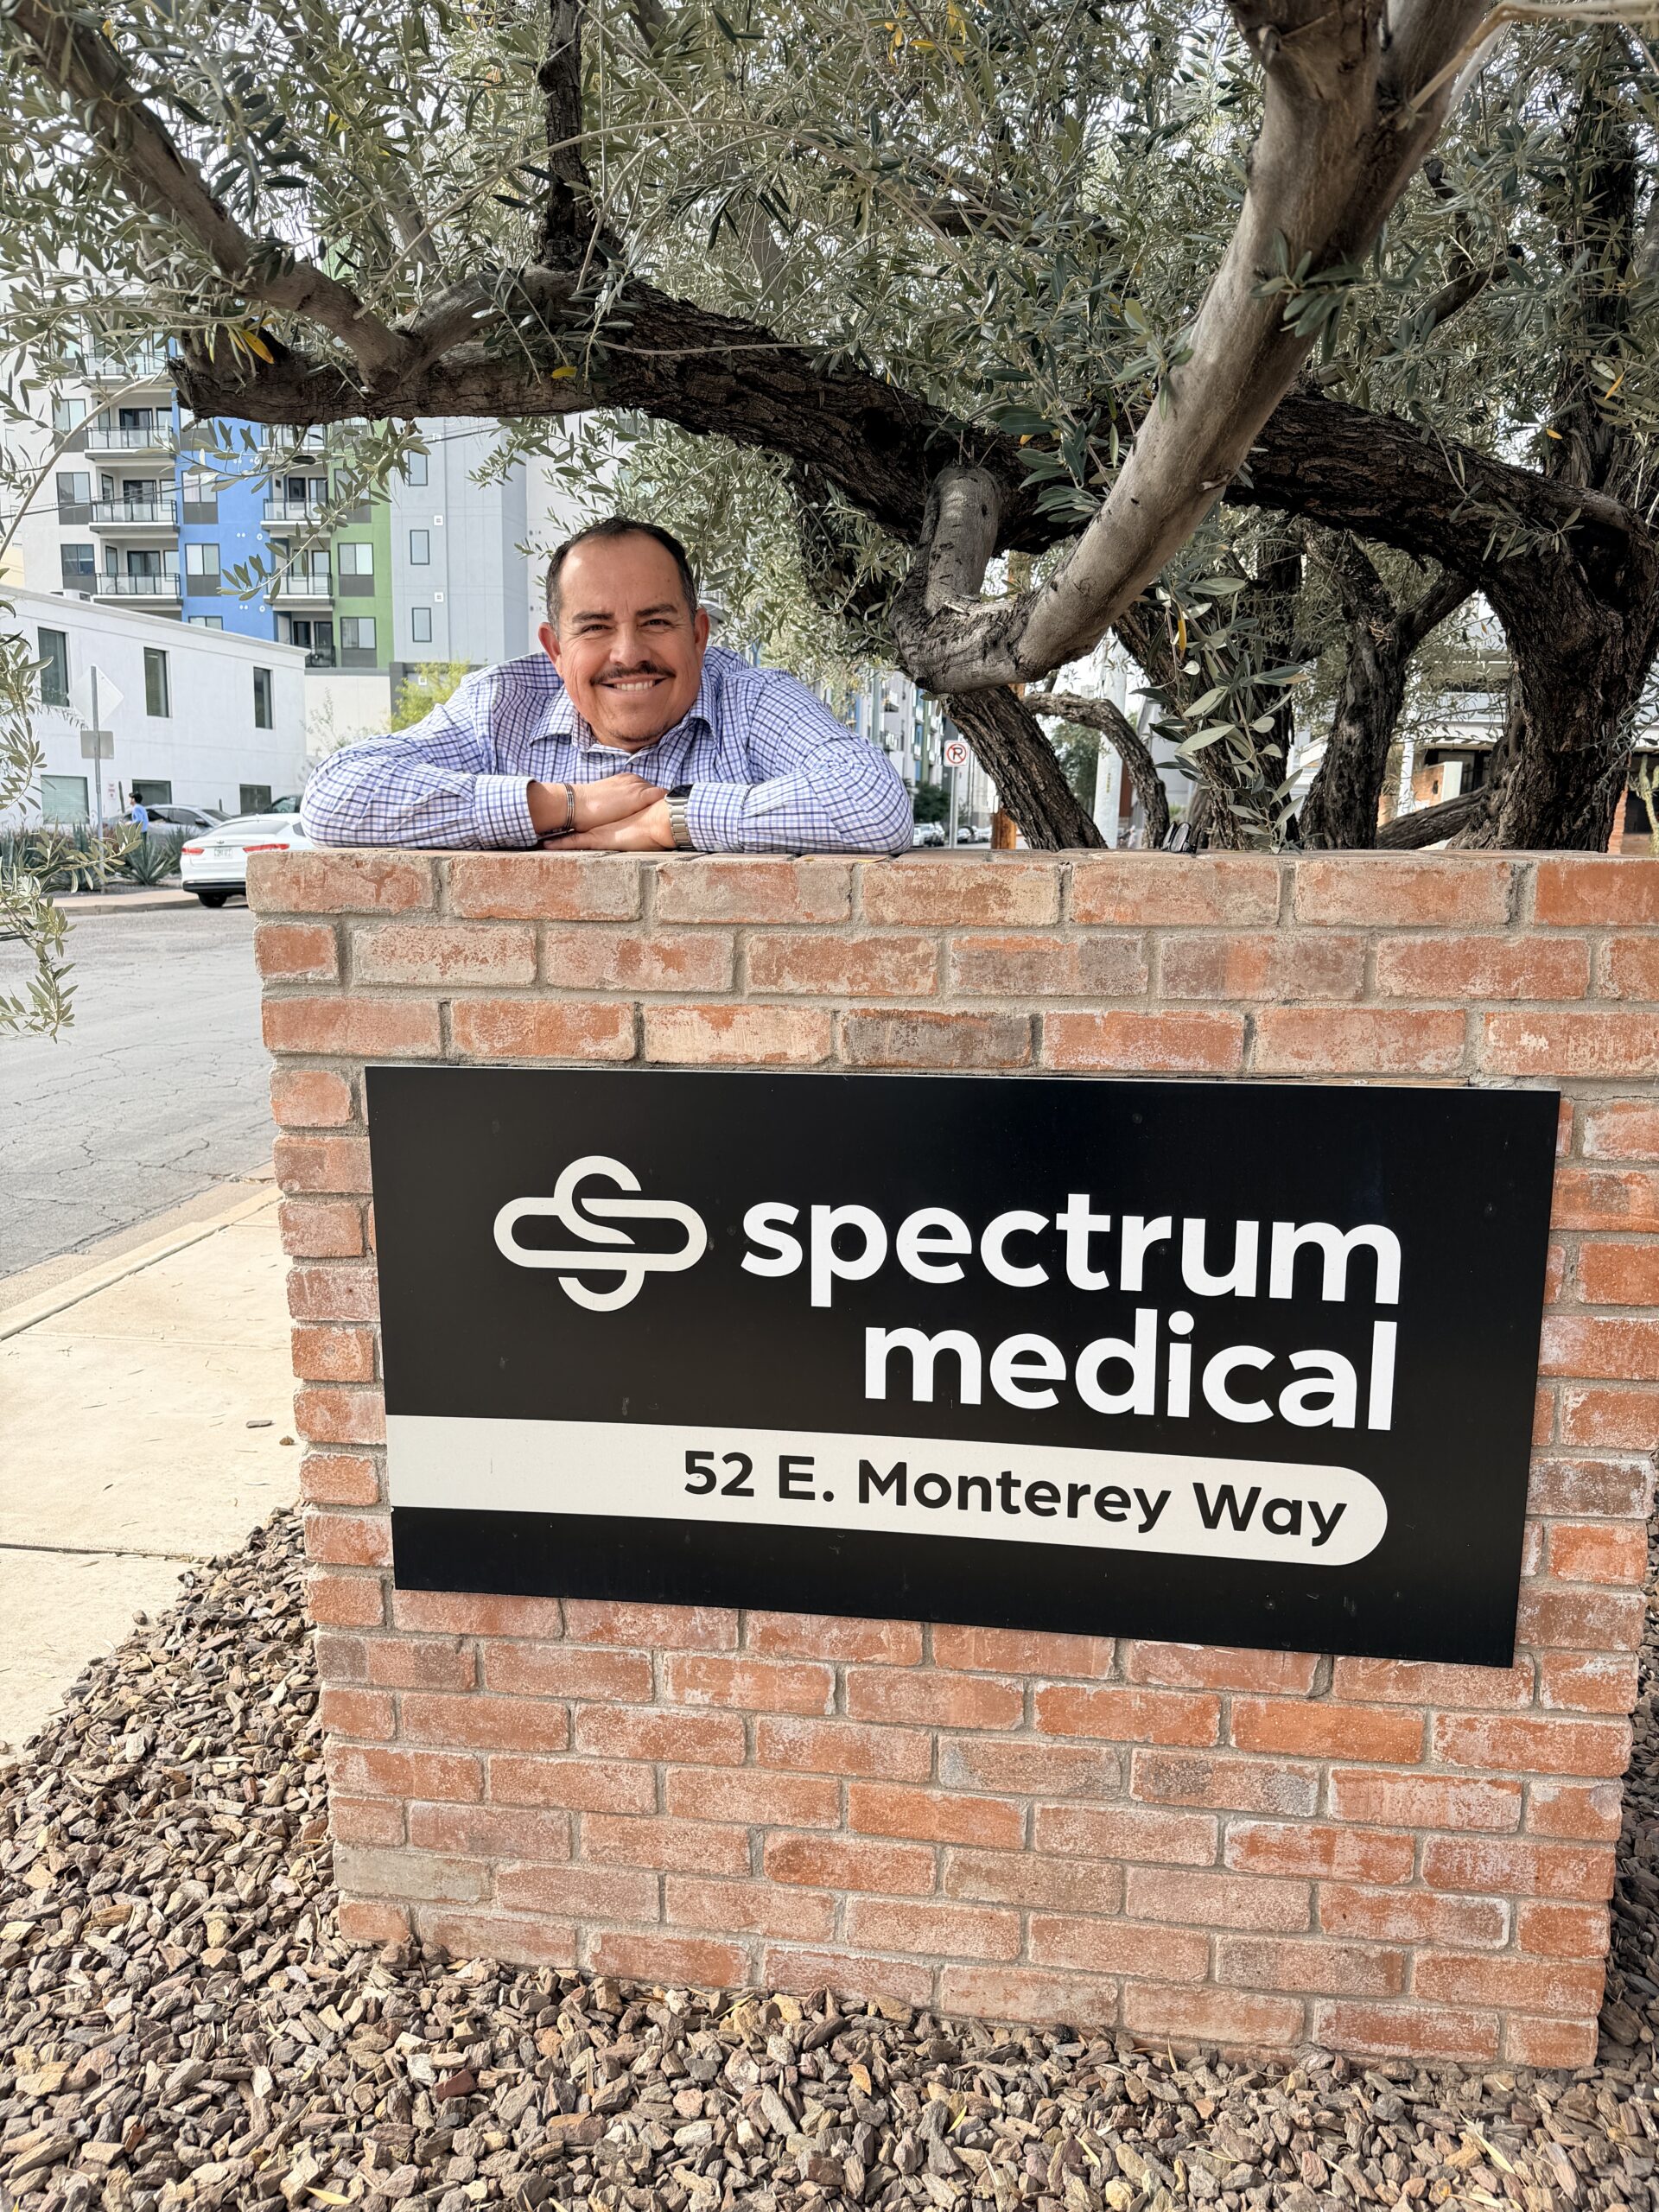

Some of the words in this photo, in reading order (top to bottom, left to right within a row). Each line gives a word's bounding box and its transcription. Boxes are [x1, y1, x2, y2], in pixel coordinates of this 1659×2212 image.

[741, 1193, 1402, 1308] spectrum
[865, 1310, 1398, 1431] medical
[685, 1451, 754, 1497] 52
[779, 1454, 835, 1503] E.
[858, 1459, 1172, 1534] Monterey
[1192, 1482, 1348, 1547] Way
